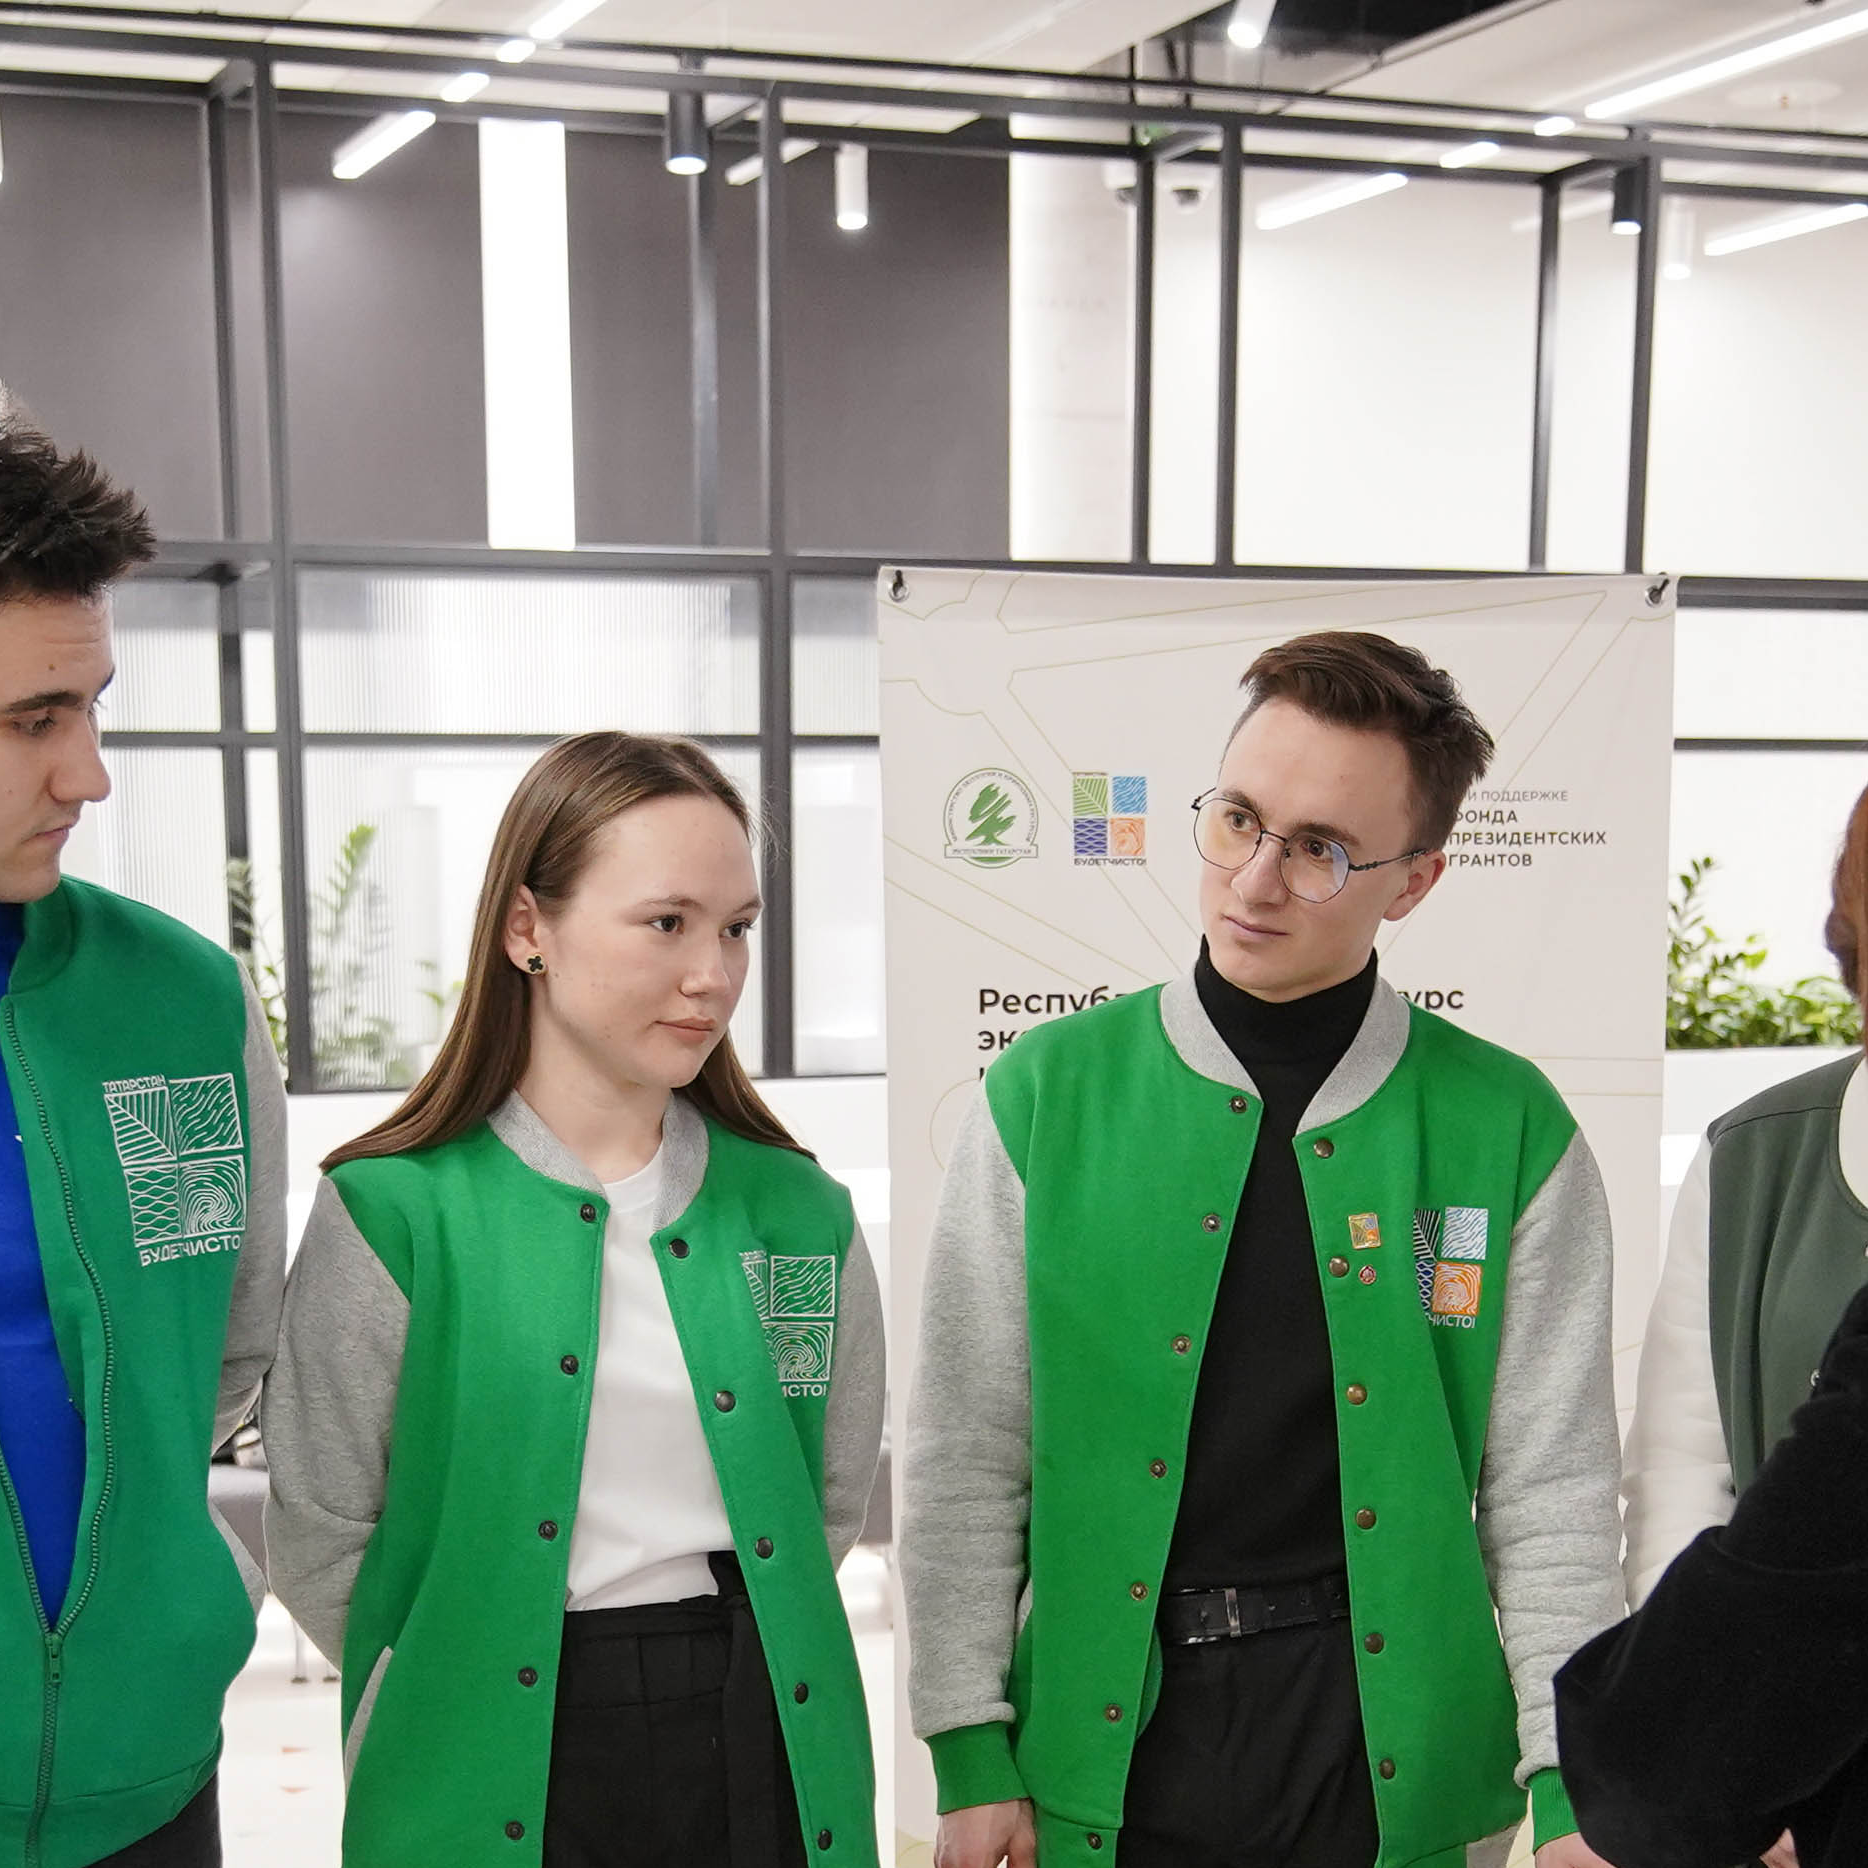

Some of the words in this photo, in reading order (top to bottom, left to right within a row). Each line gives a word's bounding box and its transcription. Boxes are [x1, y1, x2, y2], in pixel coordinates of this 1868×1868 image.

[1481, 790, 1568, 803] ПОДДЕРЖКЕ
[1449, 831, 1607, 846] ПРЕЗИДЕНТСКИХ
[1449, 853, 1532, 868] ГРАНТОВ
[979, 986, 1133, 1015] Респуб
[1396, 989, 1465, 1011] урс
